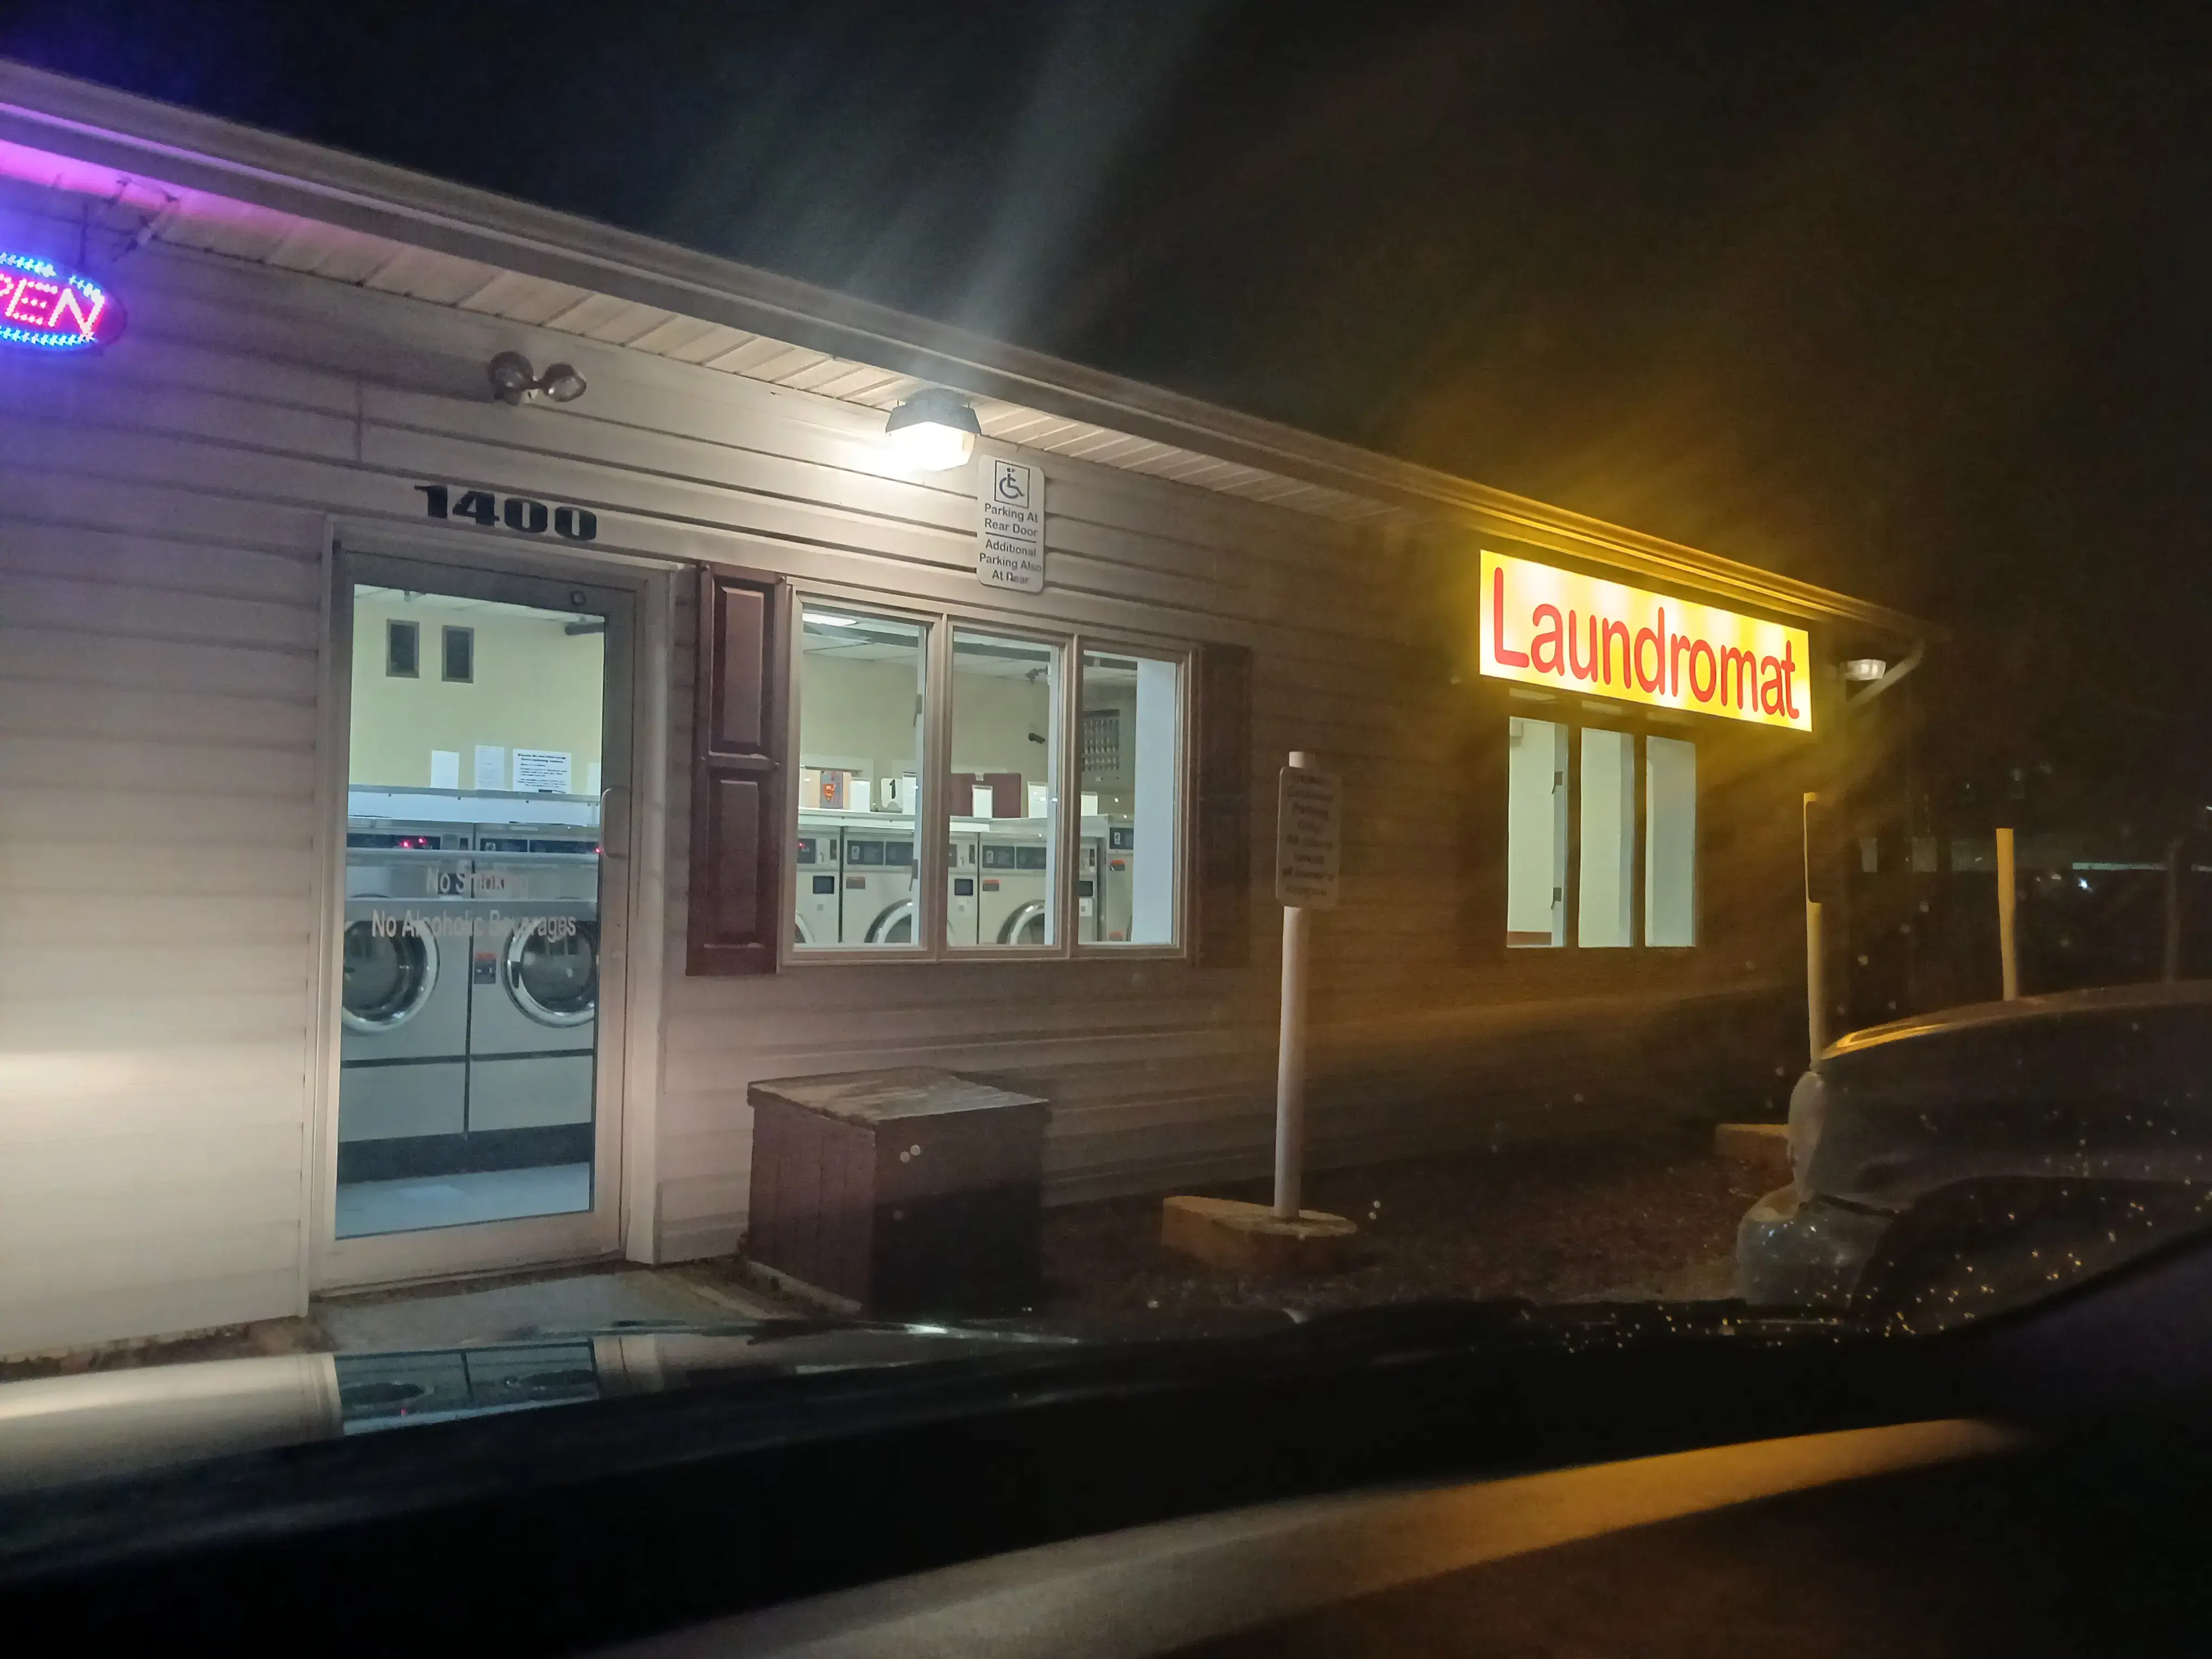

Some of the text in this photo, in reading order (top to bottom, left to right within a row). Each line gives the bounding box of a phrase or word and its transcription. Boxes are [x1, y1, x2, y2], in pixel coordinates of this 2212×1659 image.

[414, 485, 597, 541] 1400
[985, 503, 1038, 523] Parking At
[985, 518, 1038, 537] Rear Door
[985, 539, 1037, 557] Additional
[980, 552, 1042, 573] Parking Also
[992, 570, 1030, 584] At Rear
[1494, 567, 1799, 719] Laundromat
[426, 866, 451, 893] No
[372, 909, 397, 937] No
